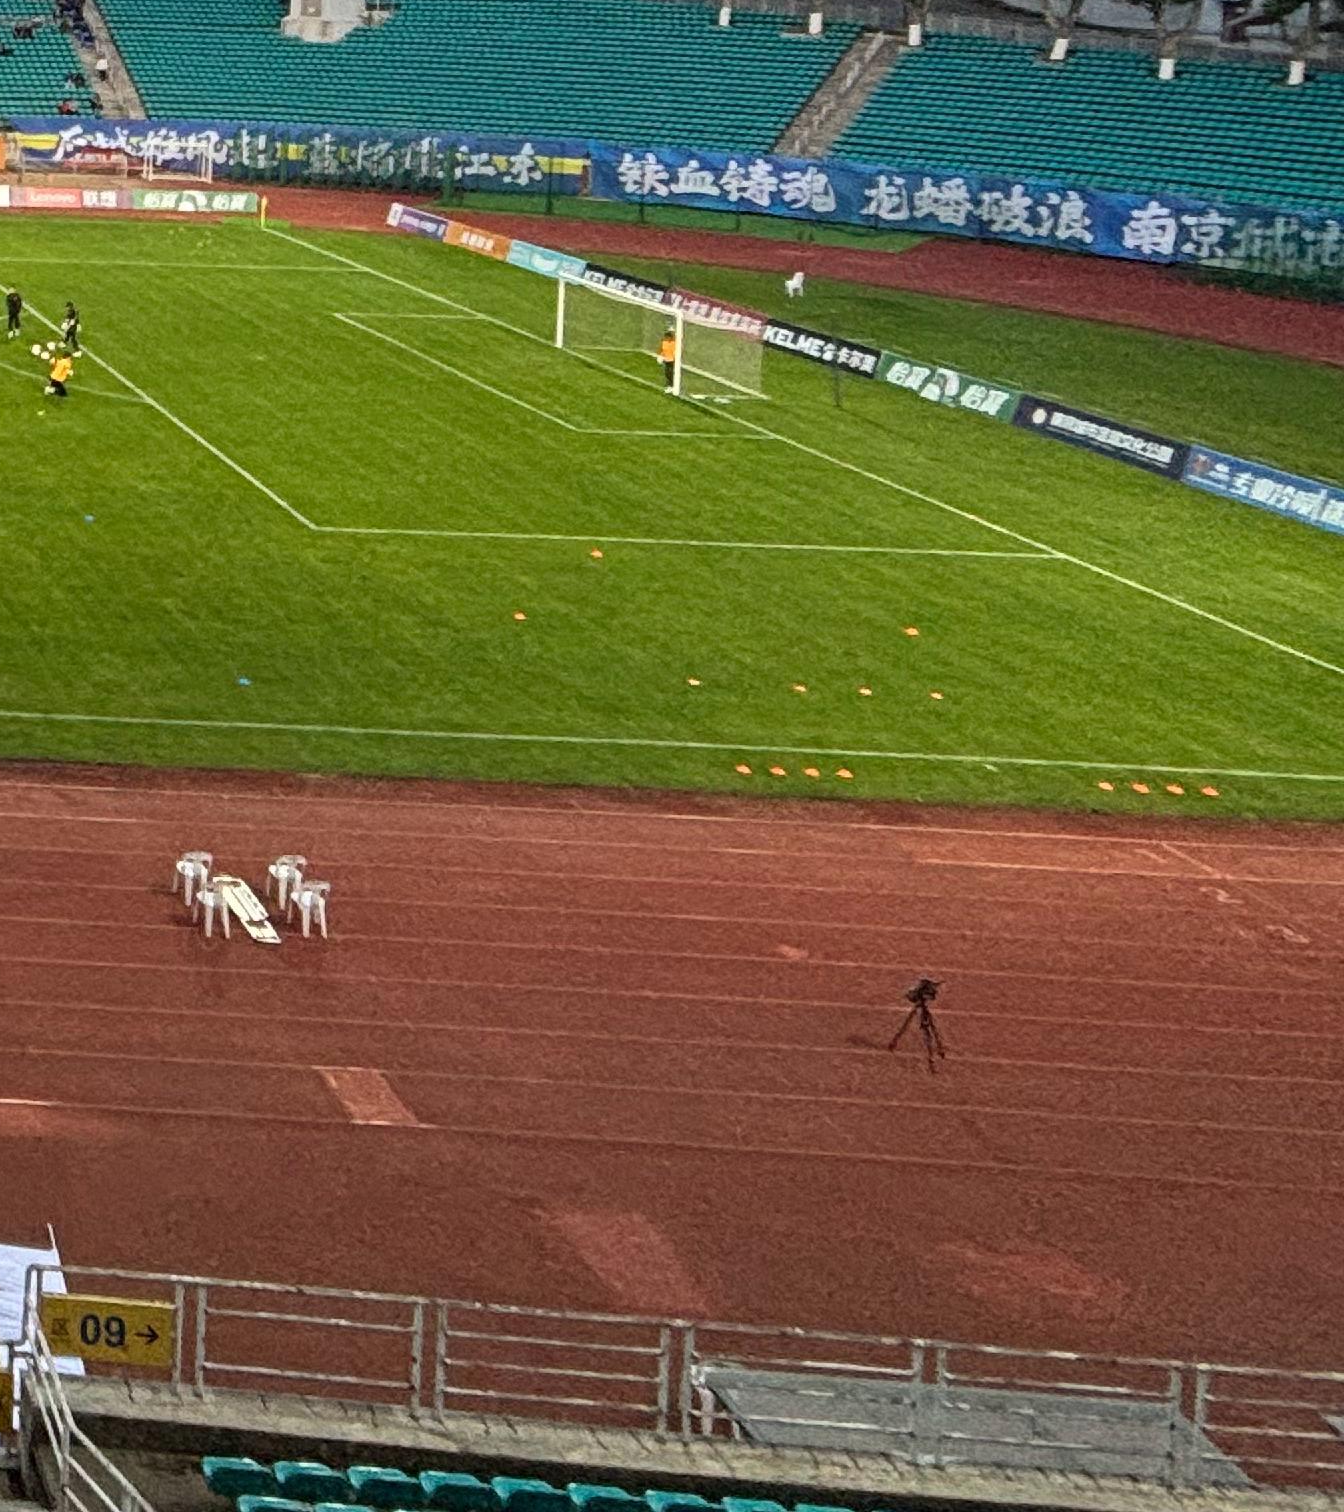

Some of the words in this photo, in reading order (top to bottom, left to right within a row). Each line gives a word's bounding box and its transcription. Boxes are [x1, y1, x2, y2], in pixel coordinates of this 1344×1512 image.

[618, 152, 837, 213] 铁血铸魂
[859, 175, 1094, 244] 龙蟠破浪
[764, 325, 826, 358] KELME
[80, 1313, 127, 1348] 09
